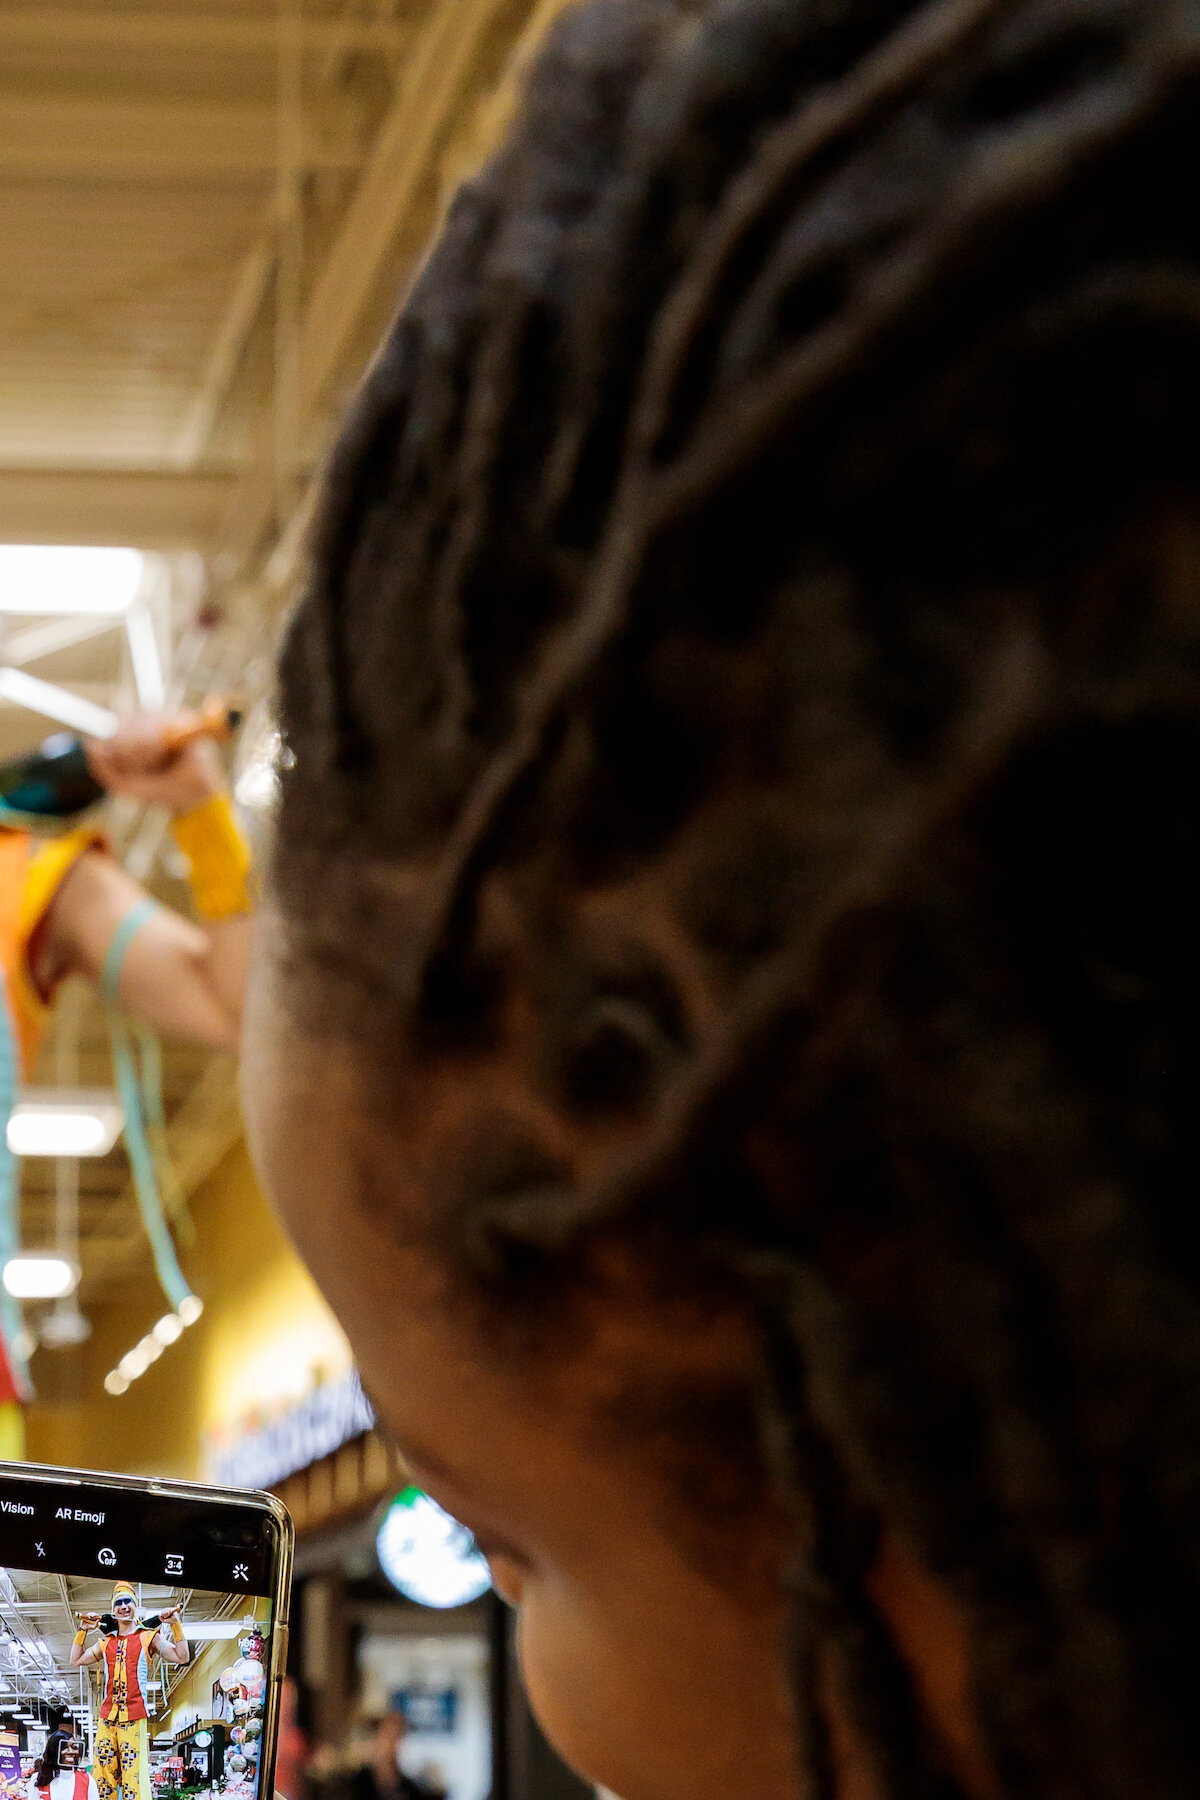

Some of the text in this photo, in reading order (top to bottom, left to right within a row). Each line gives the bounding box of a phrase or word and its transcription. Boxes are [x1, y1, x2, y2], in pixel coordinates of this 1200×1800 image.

[0, 1500, 35, 1516] Vision
[55, 1507, 105, 1526] AR Emoji
[104, 1558, 117, 1566] OFF
[167, 1560, 182, 1570] 3:4
[238, 1637, 256, 1649] HDR
